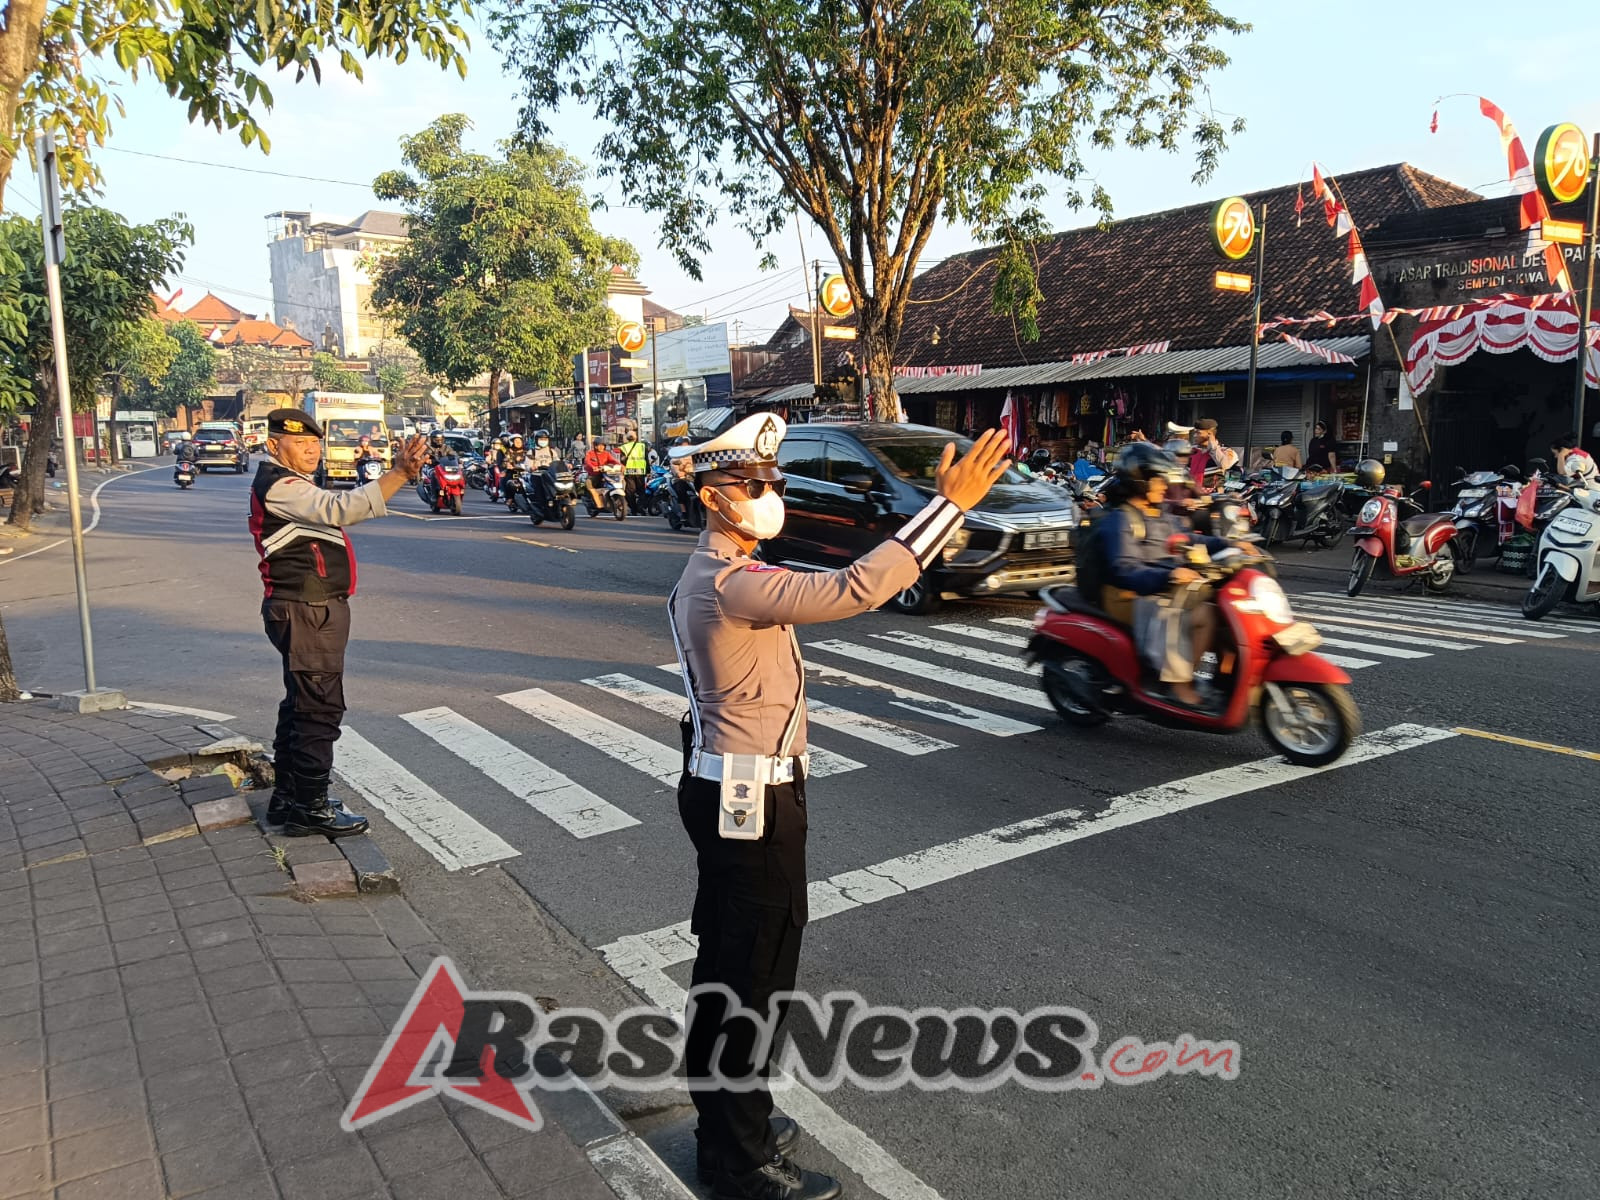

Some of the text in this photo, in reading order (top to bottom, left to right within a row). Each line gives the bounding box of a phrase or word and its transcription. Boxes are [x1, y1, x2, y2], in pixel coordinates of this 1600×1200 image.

[1551, 132, 1587, 188] 76
[1222, 204, 1252, 249] 76
[1393, 265, 1432, 283] PASAR
[1435, 254, 1518, 279] TRADISIONAL
[1457, 275, 1505, 291] SEMPIDI
[622, 325, 643, 347] 76
